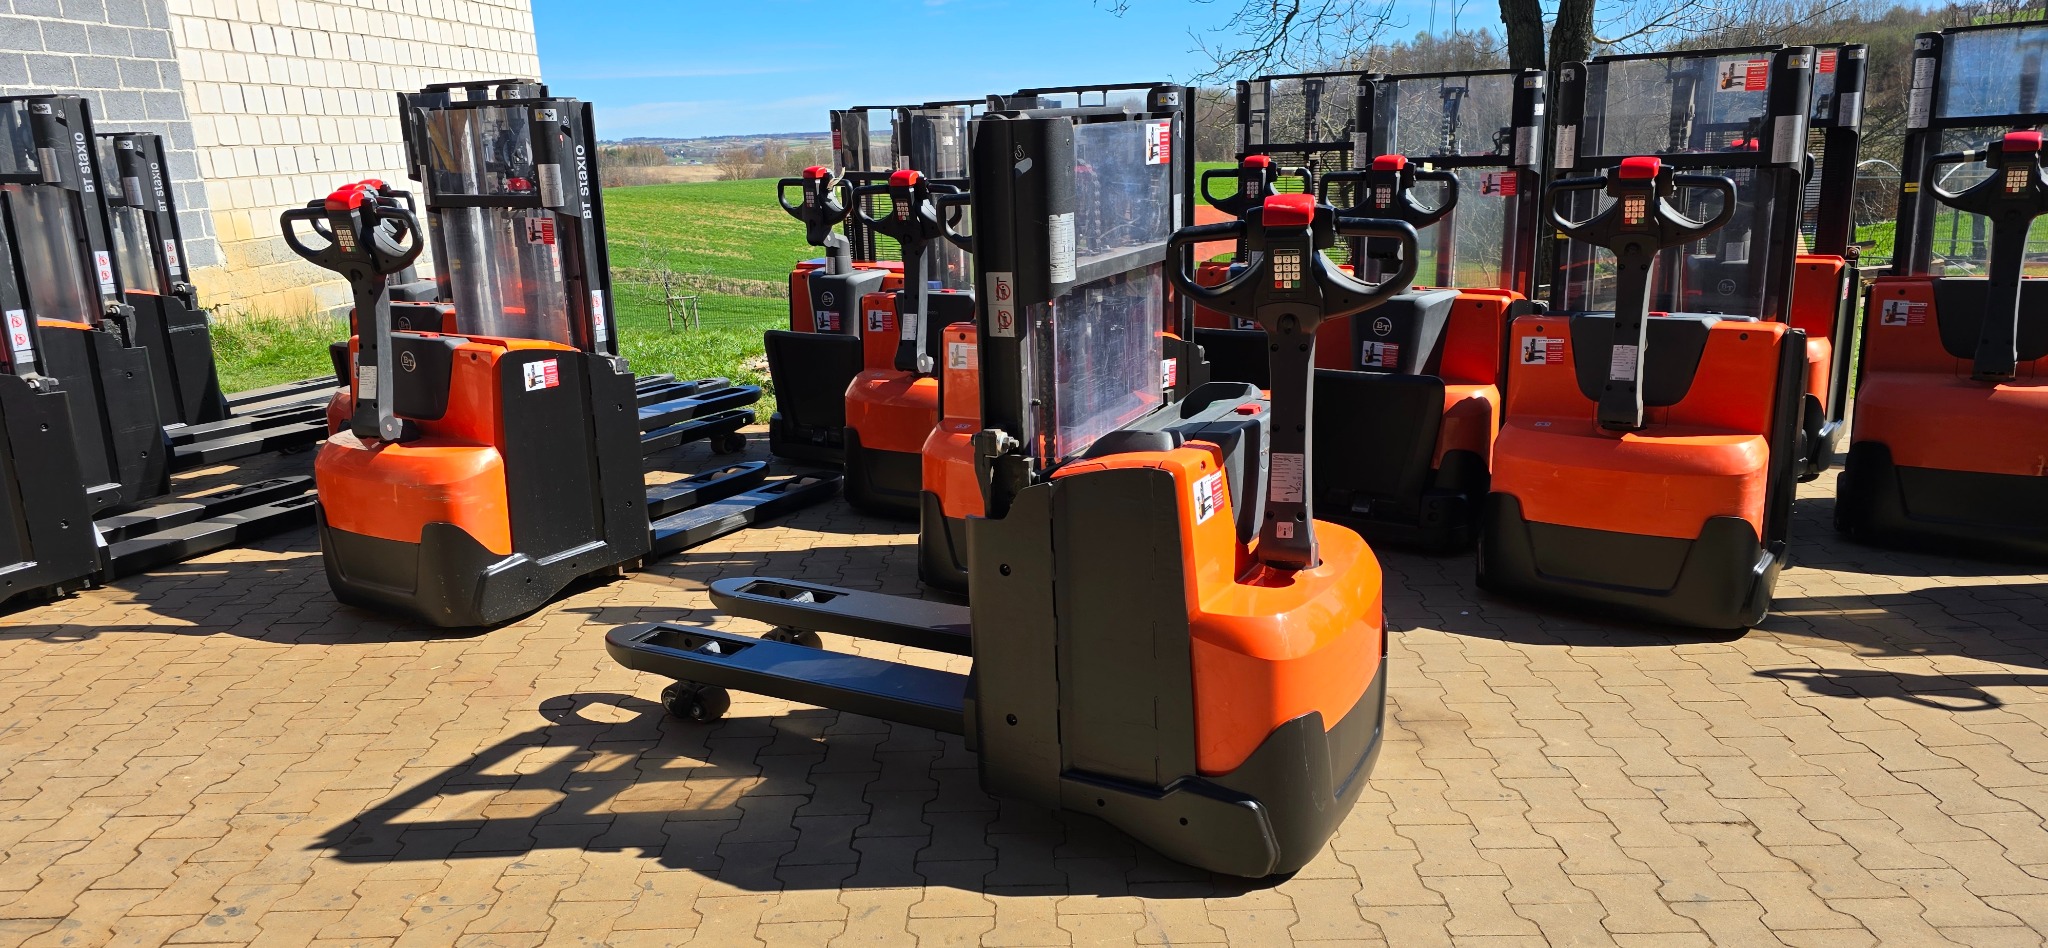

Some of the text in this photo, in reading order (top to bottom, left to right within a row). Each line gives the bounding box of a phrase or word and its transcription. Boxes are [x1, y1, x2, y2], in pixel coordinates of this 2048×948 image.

[83, 178, 95, 193] BT
[158, 200, 167, 212] BT
[582, 201, 592, 219] BT
